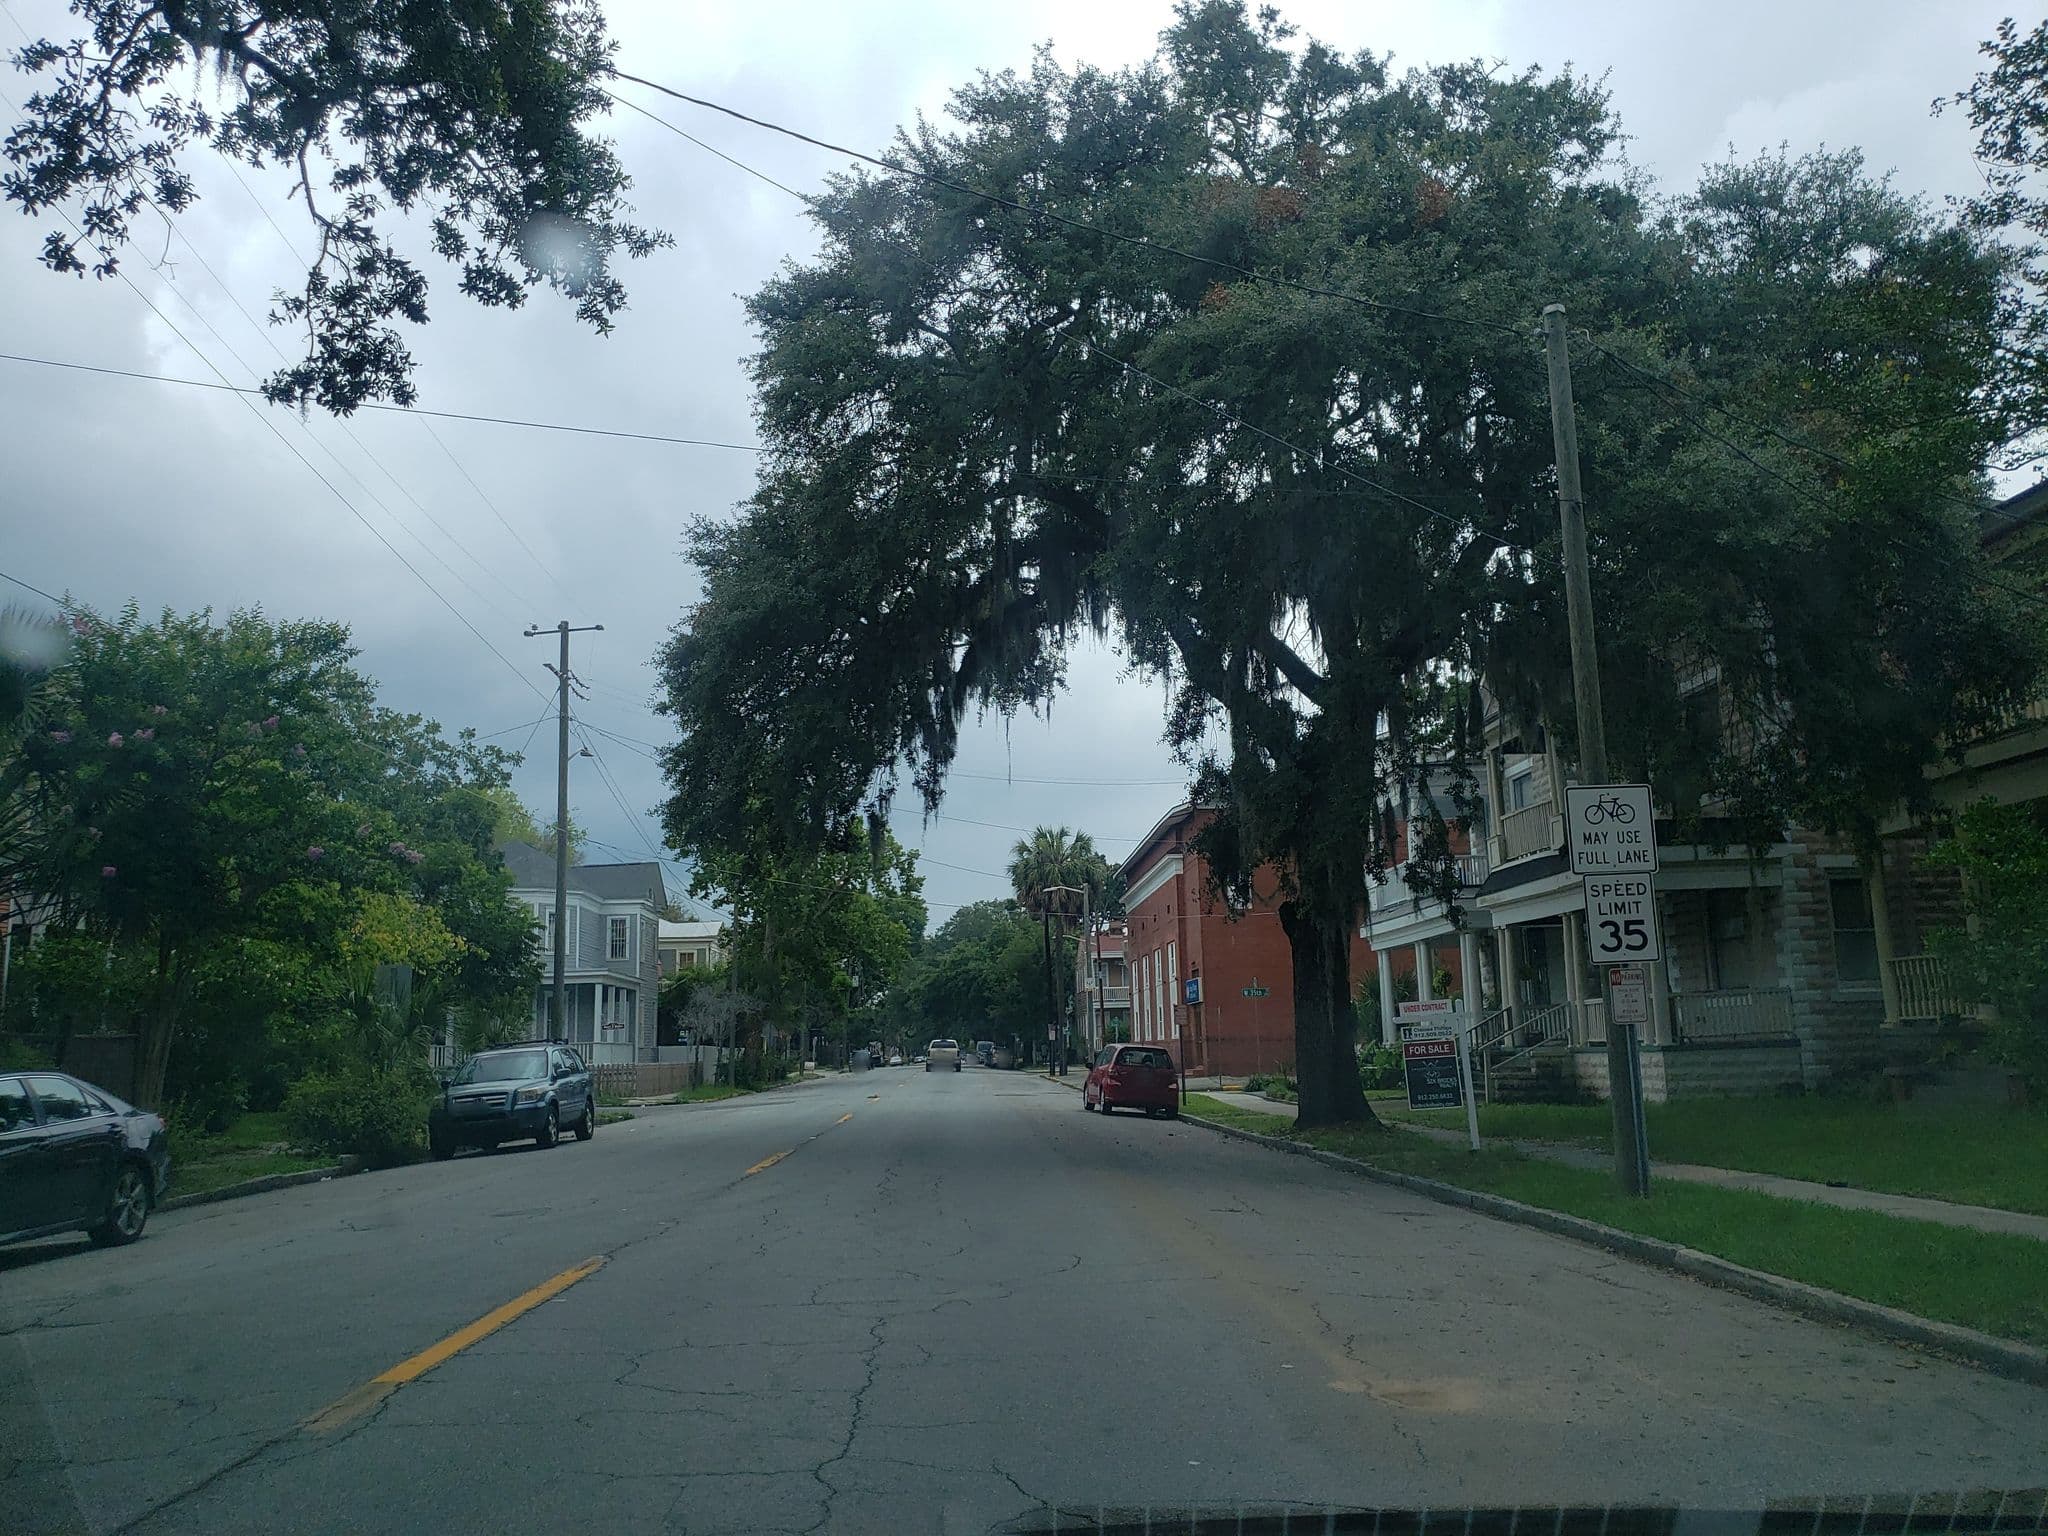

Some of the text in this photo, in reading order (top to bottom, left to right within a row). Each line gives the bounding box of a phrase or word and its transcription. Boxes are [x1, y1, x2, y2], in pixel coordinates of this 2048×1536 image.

[1583, 829, 1641, 845] MAY USE
[1578, 848, 1650, 865] FULL LANE
[1590, 883, 1647, 898] SPEED
[1598, 901, 1642, 916] LIMIT
[1598, 920, 1649, 952] 35
[1403, 1002, 1447, 1013] UNDER CONTRACT
[1409, 1044, 1451, 1055] FOR SALE
